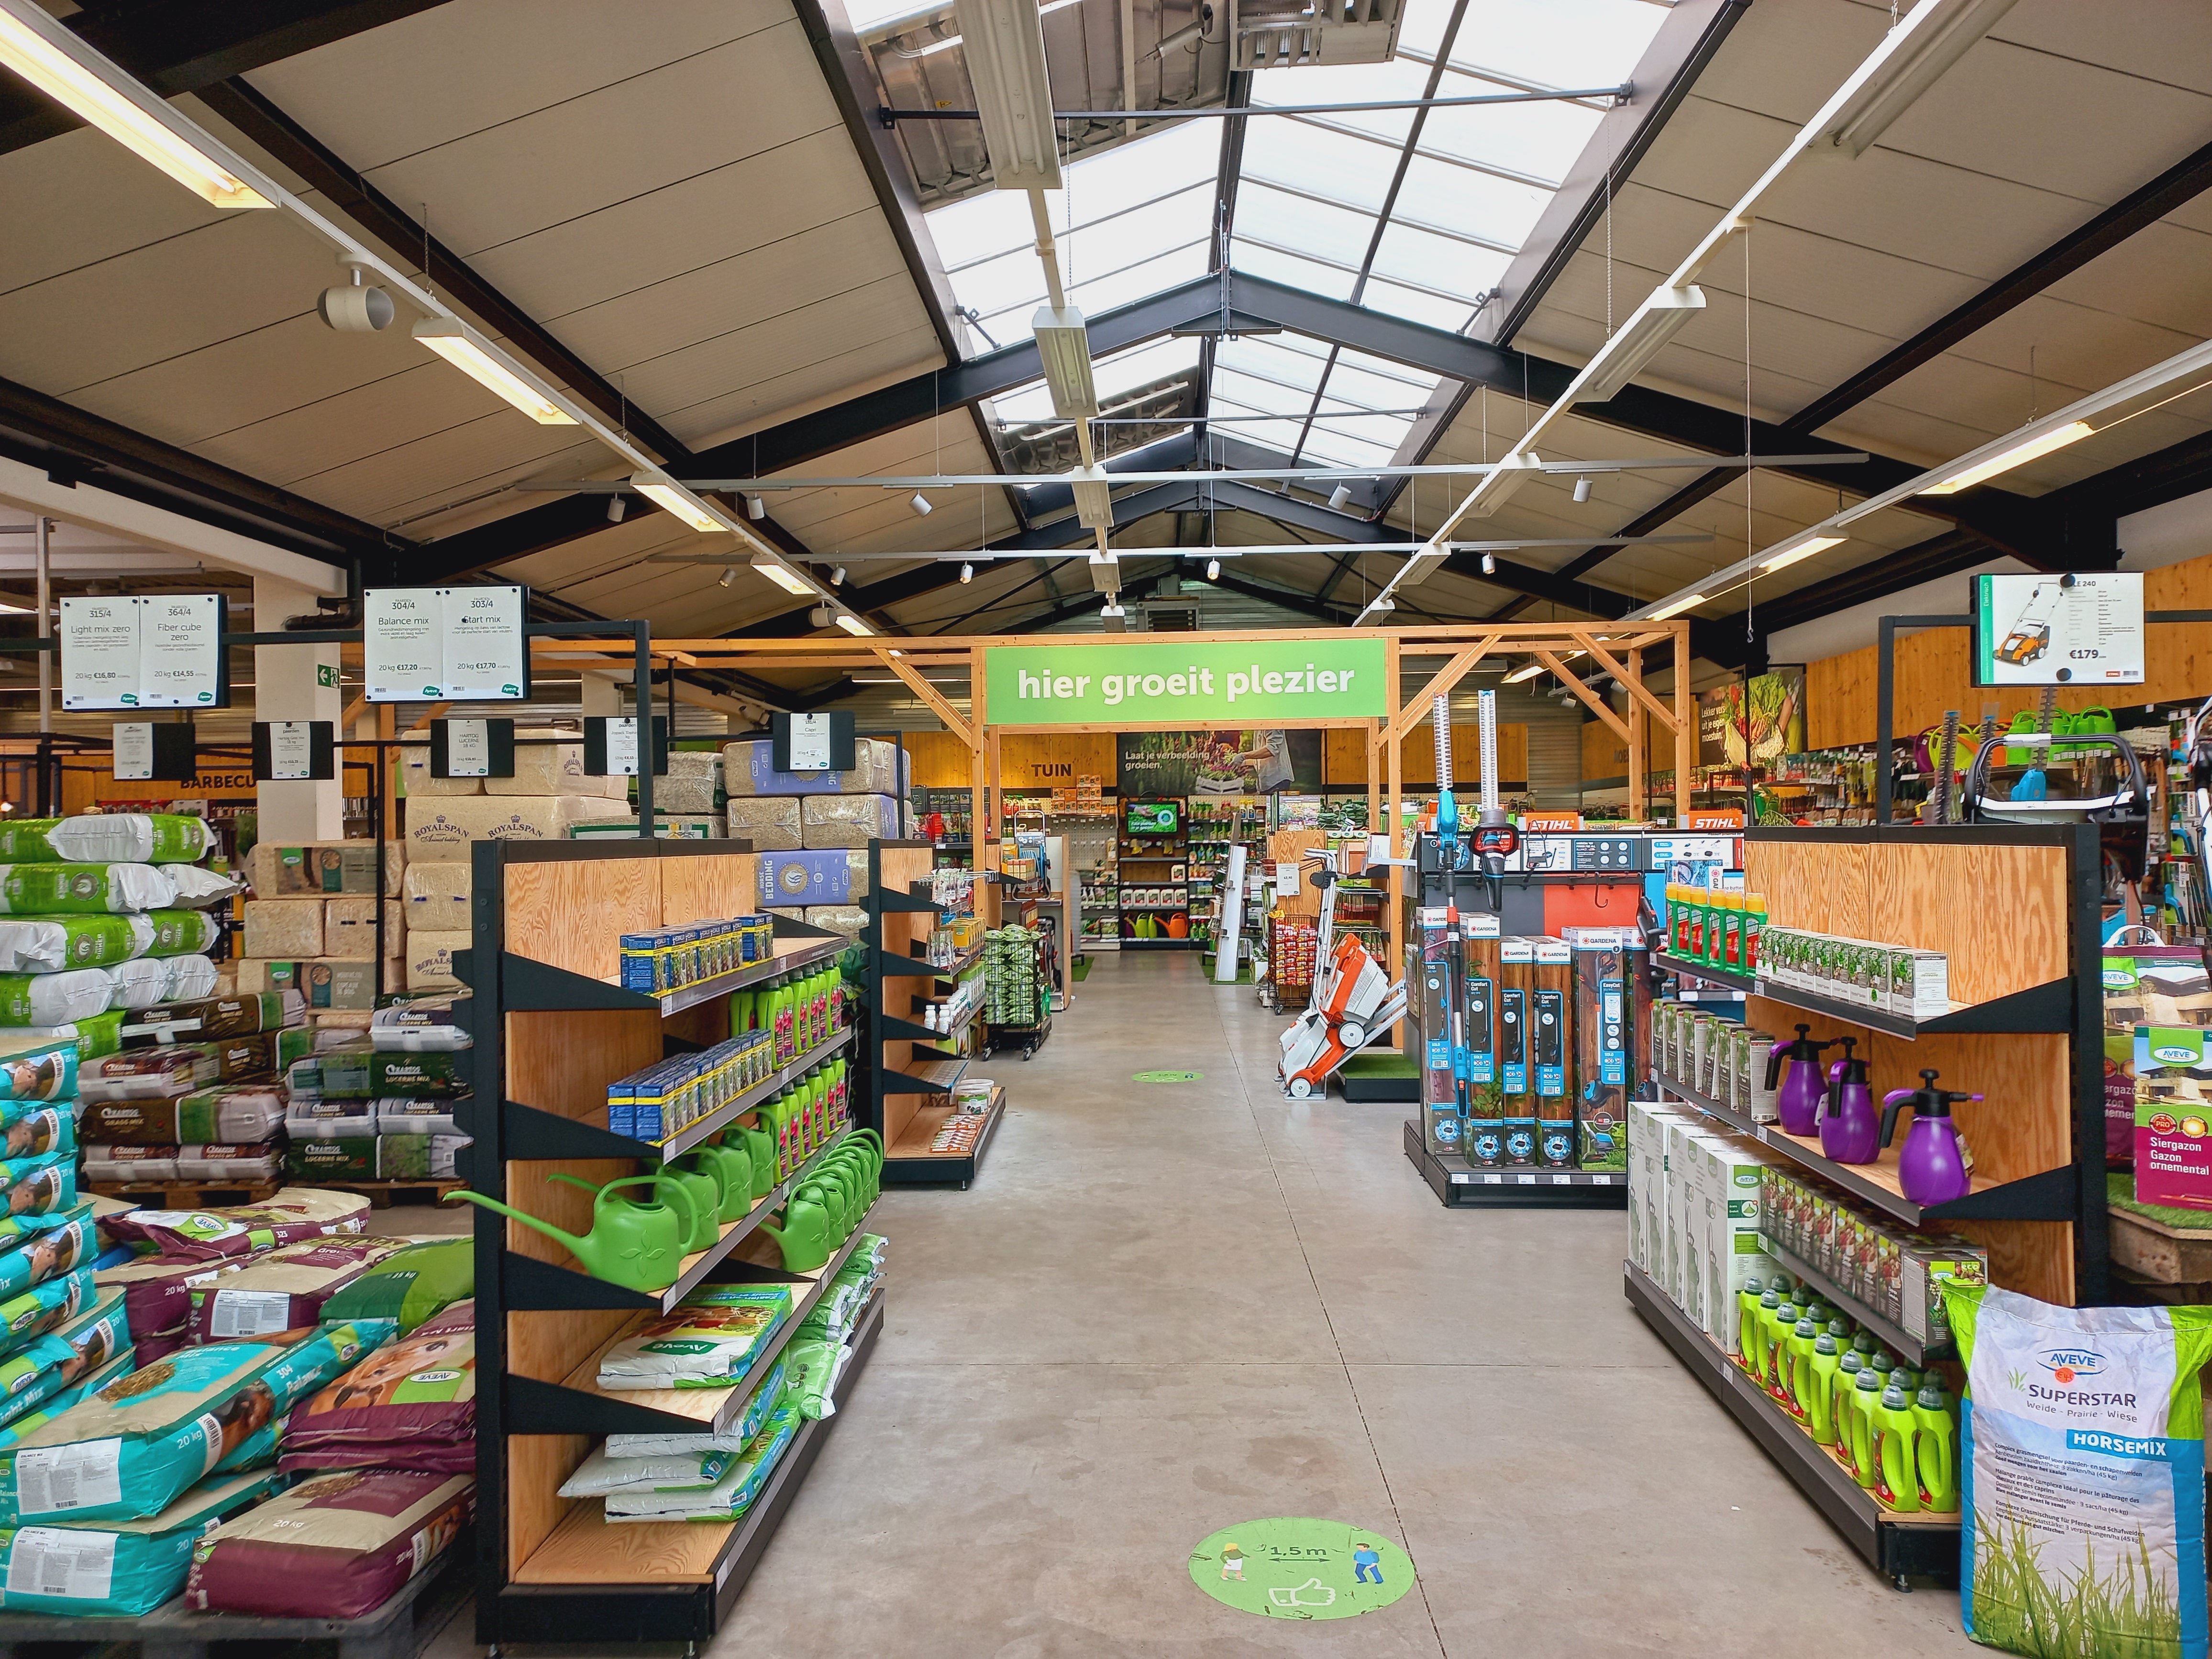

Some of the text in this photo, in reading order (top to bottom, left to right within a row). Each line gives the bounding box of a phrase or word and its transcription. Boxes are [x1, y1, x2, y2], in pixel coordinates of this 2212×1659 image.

[89, 610, 111, 618] 315/4
[378, 617, 411, 625] Balance
[71, 626, 92, 635] Light
[2070, 649, 2099, 659] €179
[1018, 663, 1355, 705] hier groeit plezier
[1702, 706, 1725, 718] Lekker vers
[1708, 721, 1712, 731] je
[1713, 719, 1725, 730] eigen
[1702, 730, 1723, 742] moestuin.
[1126, 751, 1210, 762] Laat je verbeelding
[1030, 763, 1072, 778] TUIN
[1125, 761, 1162, 771] groeien.
[180, 775, 256, 788] BARBECU
[1531, 820, 1573, 830] STIHL
[1694, 818, 1737, 829] STIHL
[413, 824, 470, 838] ROYALSPAN
[487, 823, 543, 839] ROYALSPAN
[764, 860, 774, 899] BEDDING
[2163, 1050, 2190, 1058] AVEVE
[60, 1110, 67, 1118] 20
[2150, 1137, 2201, 1152] Siergazon
[2150, 1150, 2181, 1162] Gazon
[2150, 1161, 2209, 1175] ornemental
[165, 1285, 185, 1296] 20 kg
[653, 1343, 708, 1351] Aveve
[2050, 1353, 2096, 1367] AVEVE
[276, 1364, 294, 1379] 304
[15, 1374, 33, 1389] AVEVE
[286, 1365, 323, 1395] Balance
[24, 1387, 44, 1407] Mix
[2029, 1384, 2137, 1409] SUPERSTAR
[2027, 1400, 2056, 1413] Weide
[2108, 1410, 2137, 1423] Wiese
[177, 1430, 203, 1449] 20 kg
[2074, 1433, 2167, 1456] HORSEMIX
[1995, 1443, 2015, 1452] Complex
[2016, 1449, 2050, 1460] grasmengsel
[2066, 1467, 2095, 1476] zakken/ha
[1995, 1469, 2016, 1478] Mélange
[2017, 1475, 2035, 1483] prairie
[2035, 1479, 2062, 1489] complexe
[2101, 1492, 2128, 1502] pâturage
[1996, 1475, 2015, 1485] chevaux
[2035, 1486, 2055, 1494] caprins
[2022, 1488, 2036, 1496] semis
[2037, 1493, 2076, 1506] recommandée
[2085, 1503, 2107, 1512] sacs/ha
[1996, 1500, 2020, 1511] Komplexe
[2021, 1507, 2060, 1522] Grasmischung
[2071, 1518, 2093, 1528] Pferde-
[273, 1520, 304, 1529] 20 kg
[2070, 1527, 2120, 1541] verpackungen/ha
[176, 1539, 190, 1553] 20
[1271, 1546, 1327, 1557] 1,5 m
